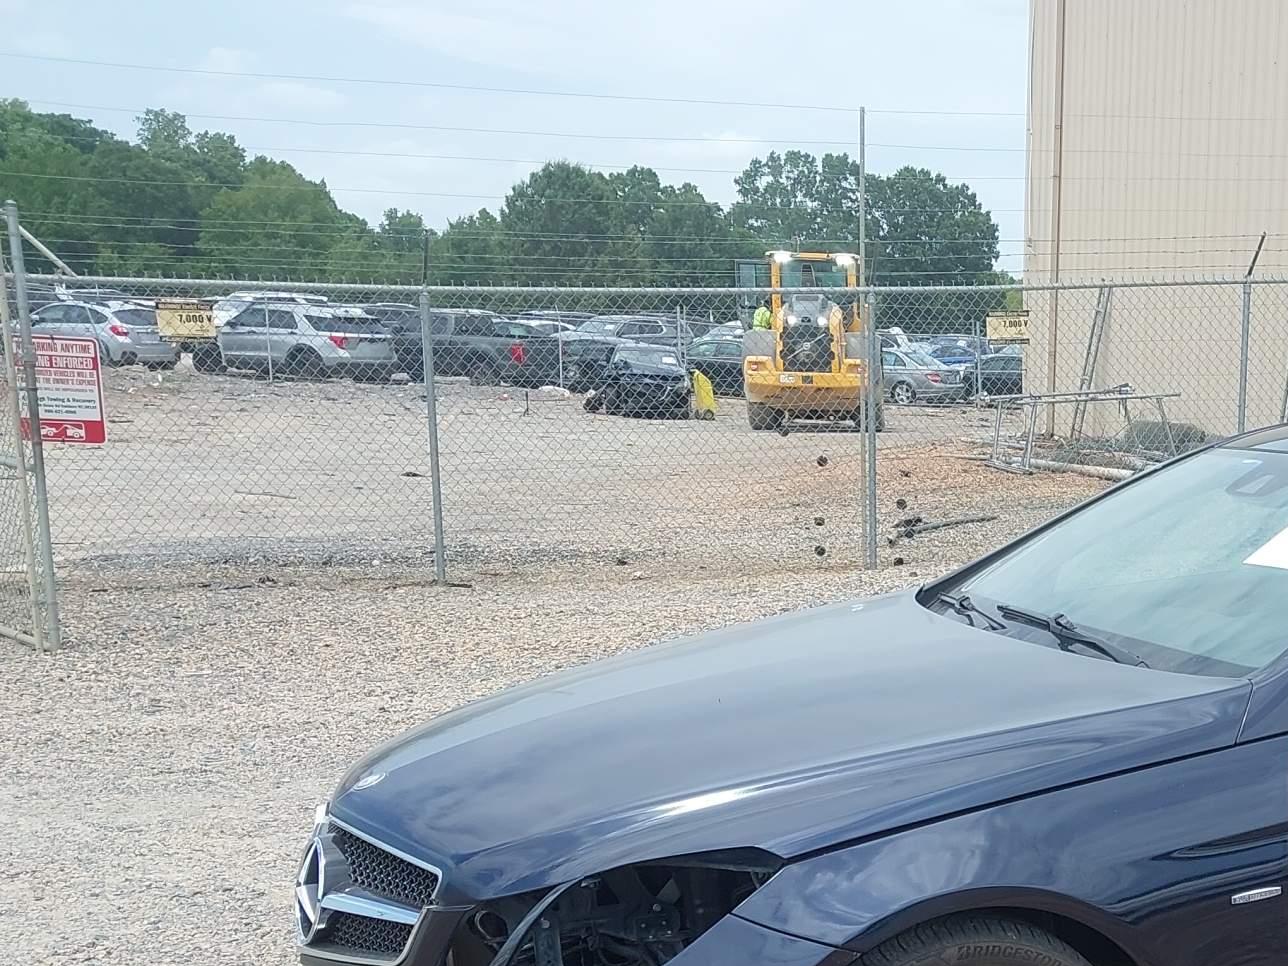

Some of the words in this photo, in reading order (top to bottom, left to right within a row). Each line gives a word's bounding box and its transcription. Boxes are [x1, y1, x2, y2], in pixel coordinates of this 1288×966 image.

[178, 314, 204, 324] 7,000
[206, 314, 212, 323] V
[1002, 320, 1022, 328] 7,000
[33, 341, 58, 353] ARKING
[60, 343, 92, 354] ANYTIME
[52, 356, 93, 369] ENFORCED
